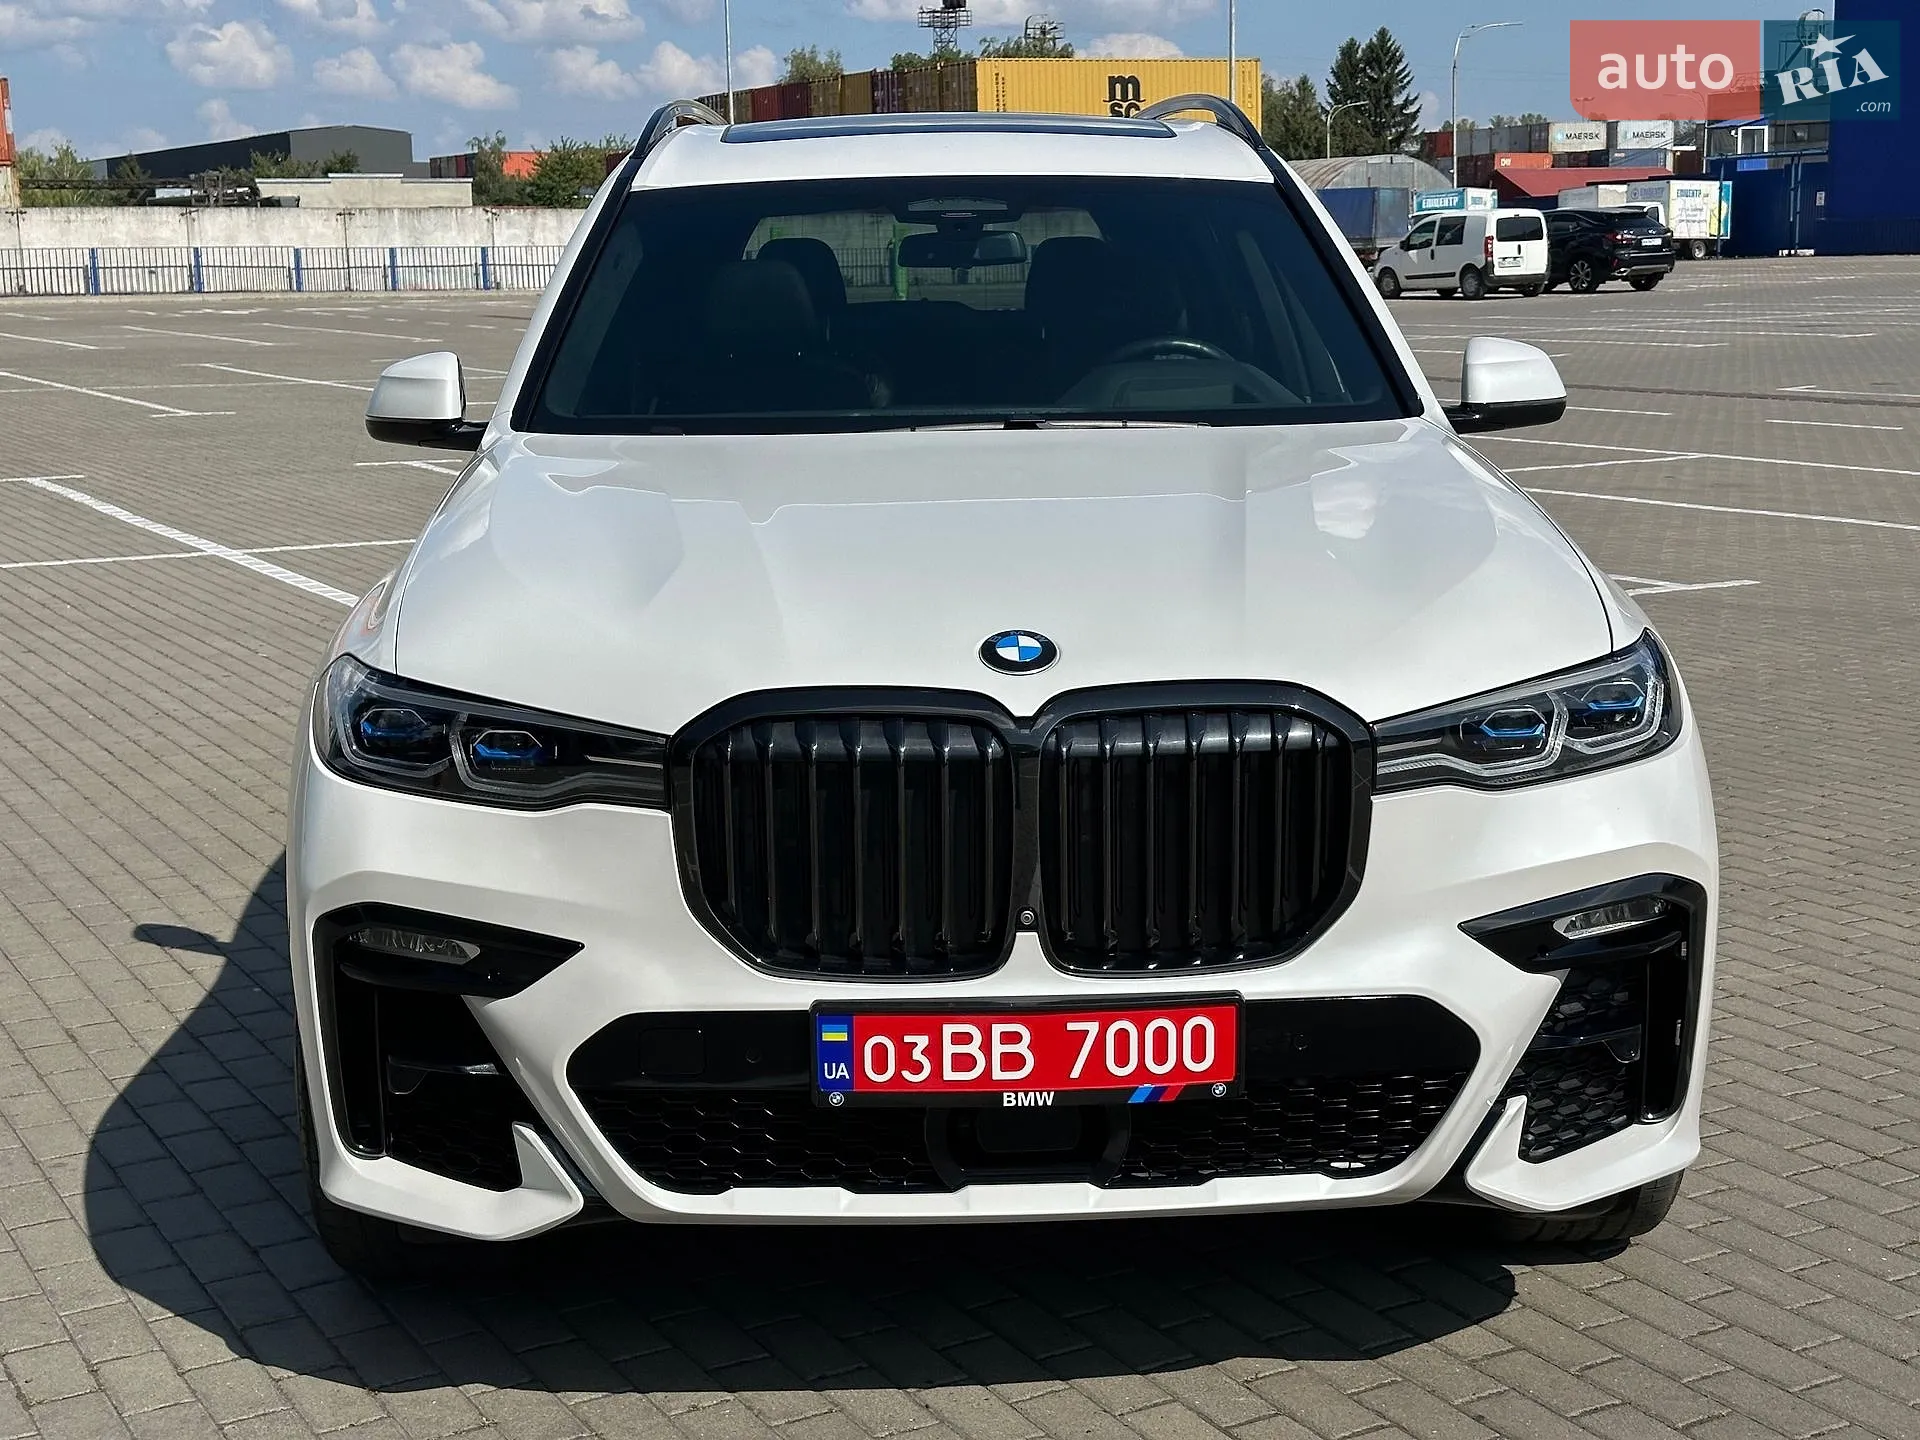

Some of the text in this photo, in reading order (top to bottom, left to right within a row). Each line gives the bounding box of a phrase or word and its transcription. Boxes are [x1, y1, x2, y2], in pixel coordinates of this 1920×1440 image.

[1565, 131, 1600, 140] MAERSK
[1632, 130, 1666, 139] MAERSK
[1422, 196, 1459, 209] ЕПІЦЕНТР
[1066, 1015, 1216, 1080] 7000
[824, 1062, 850, 1080] UA
[1002, 1090, 1055, 1107] BMW
